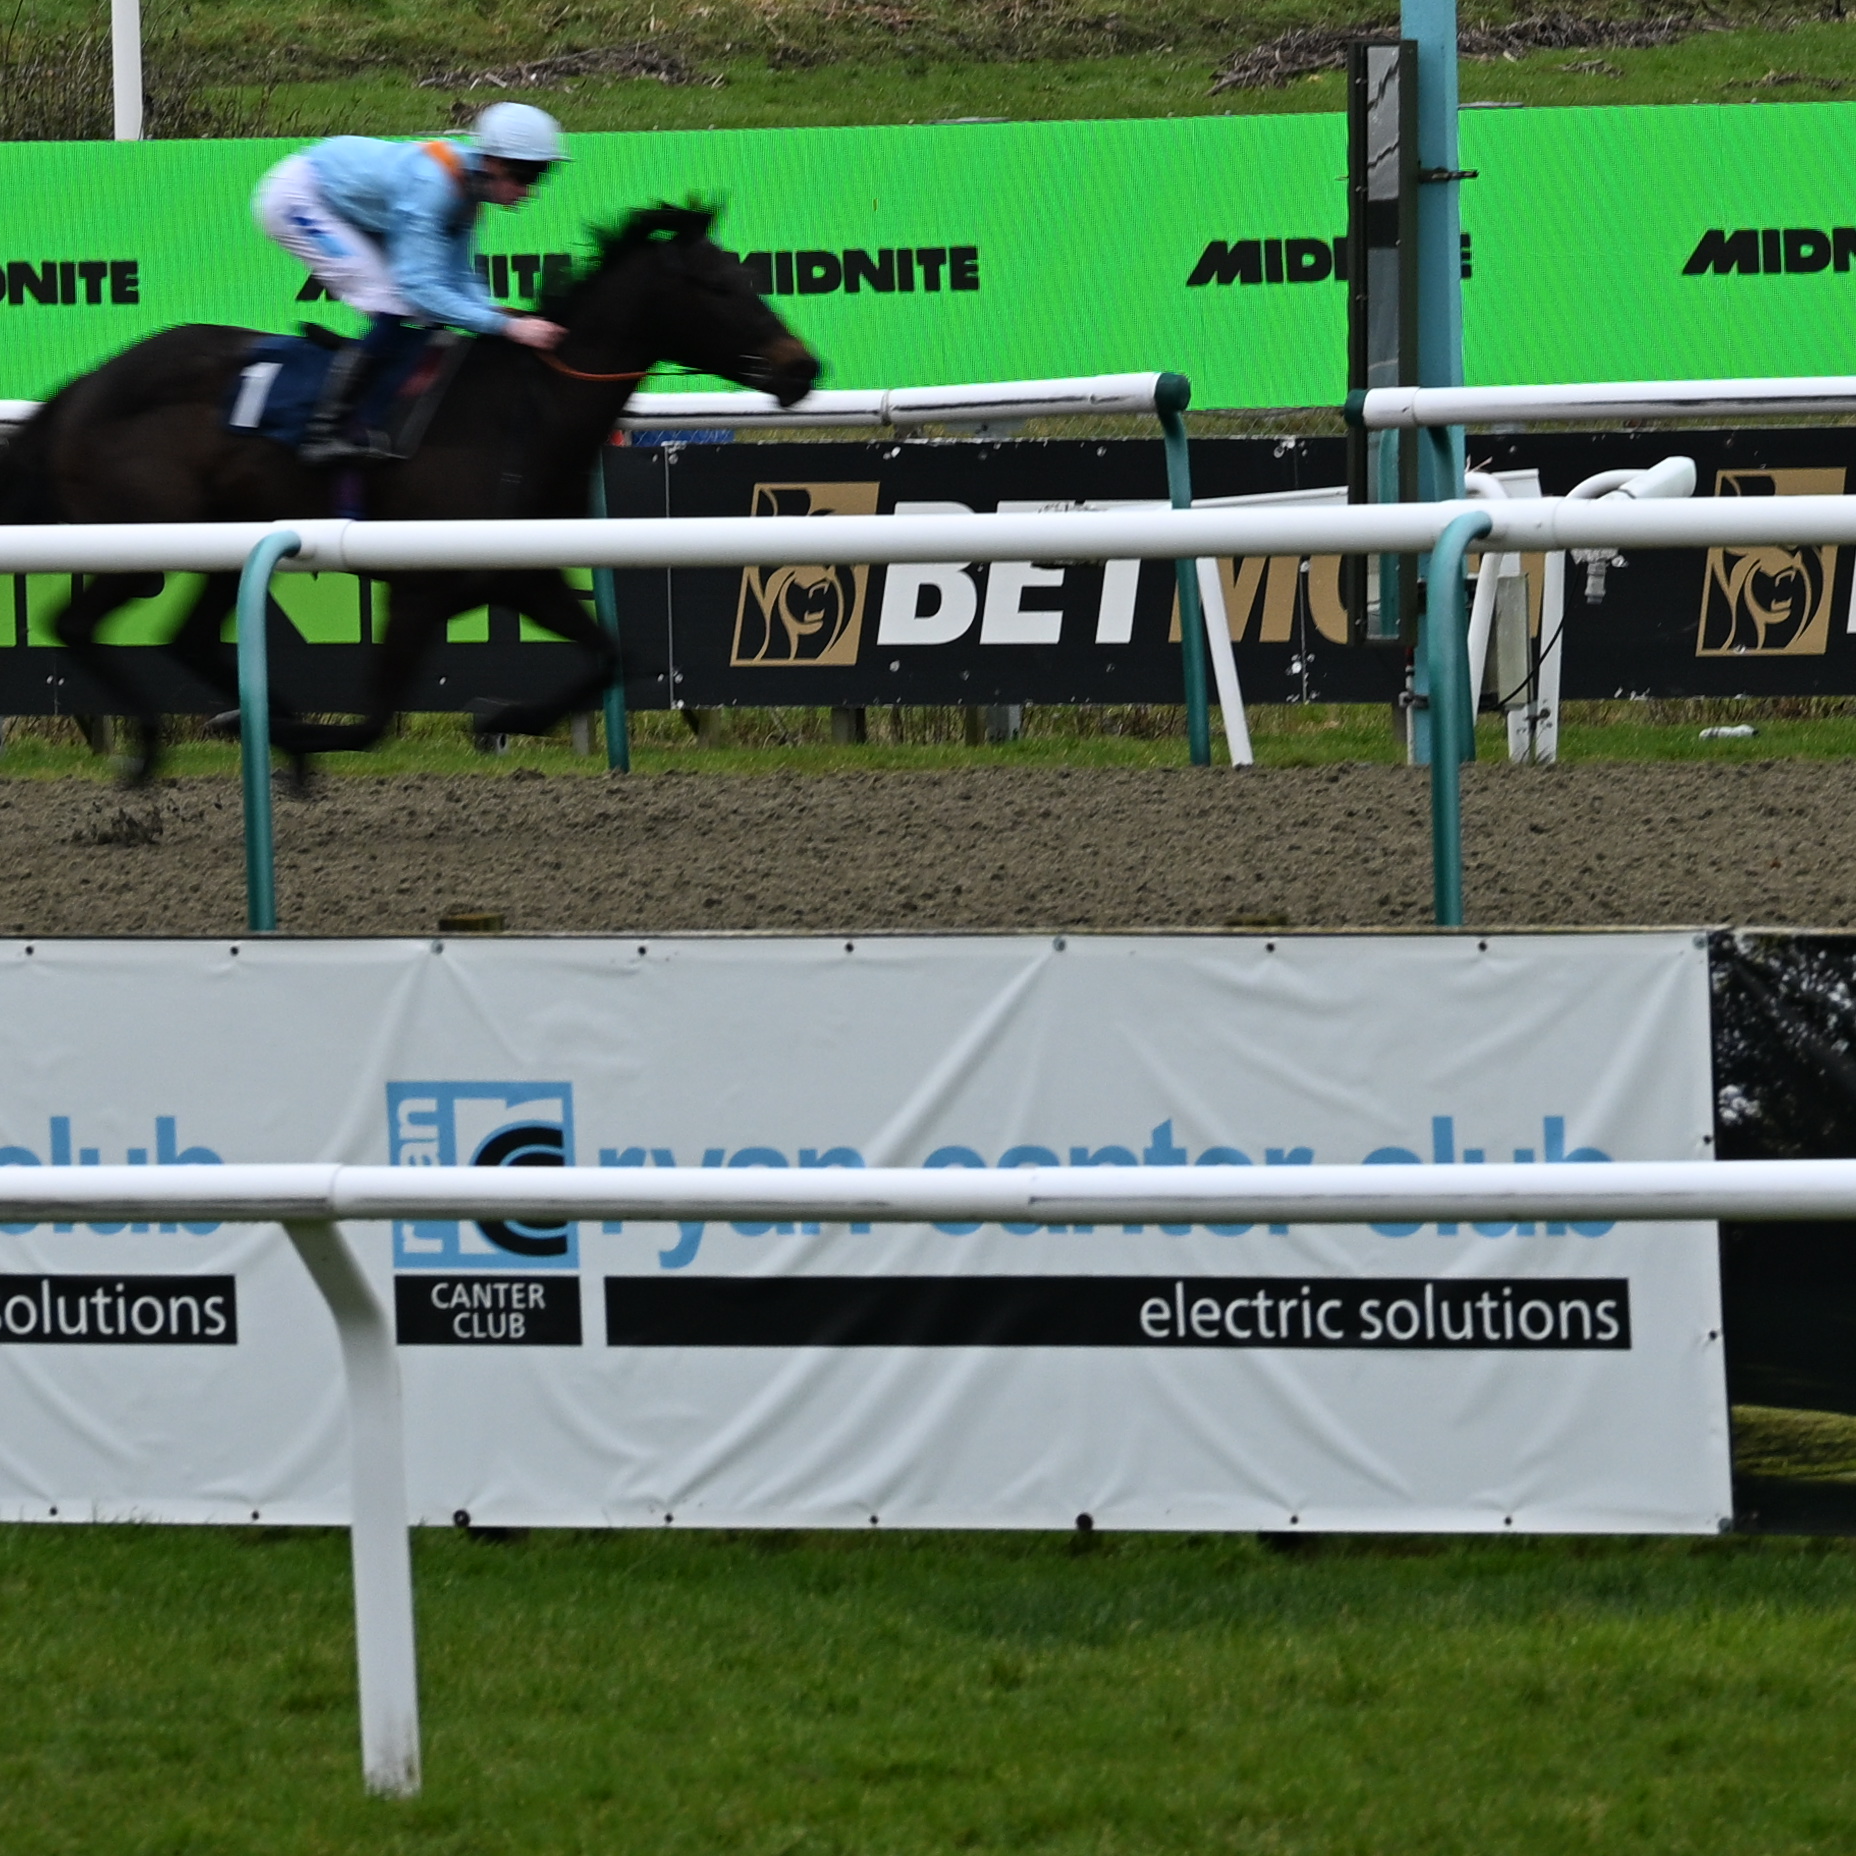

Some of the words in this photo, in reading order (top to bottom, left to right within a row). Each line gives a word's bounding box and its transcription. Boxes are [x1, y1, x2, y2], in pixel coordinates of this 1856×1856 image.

[230, 362, 284, 428] 1
[877, 500, 1544, 645] BET
[430, 1282, 546, 1310] CANTER
[453, 1311, 526, 1339] CLUB
[1140, 1281, 1344, 1339] electric
[1359, 1283, 1621, 1341] solutions
